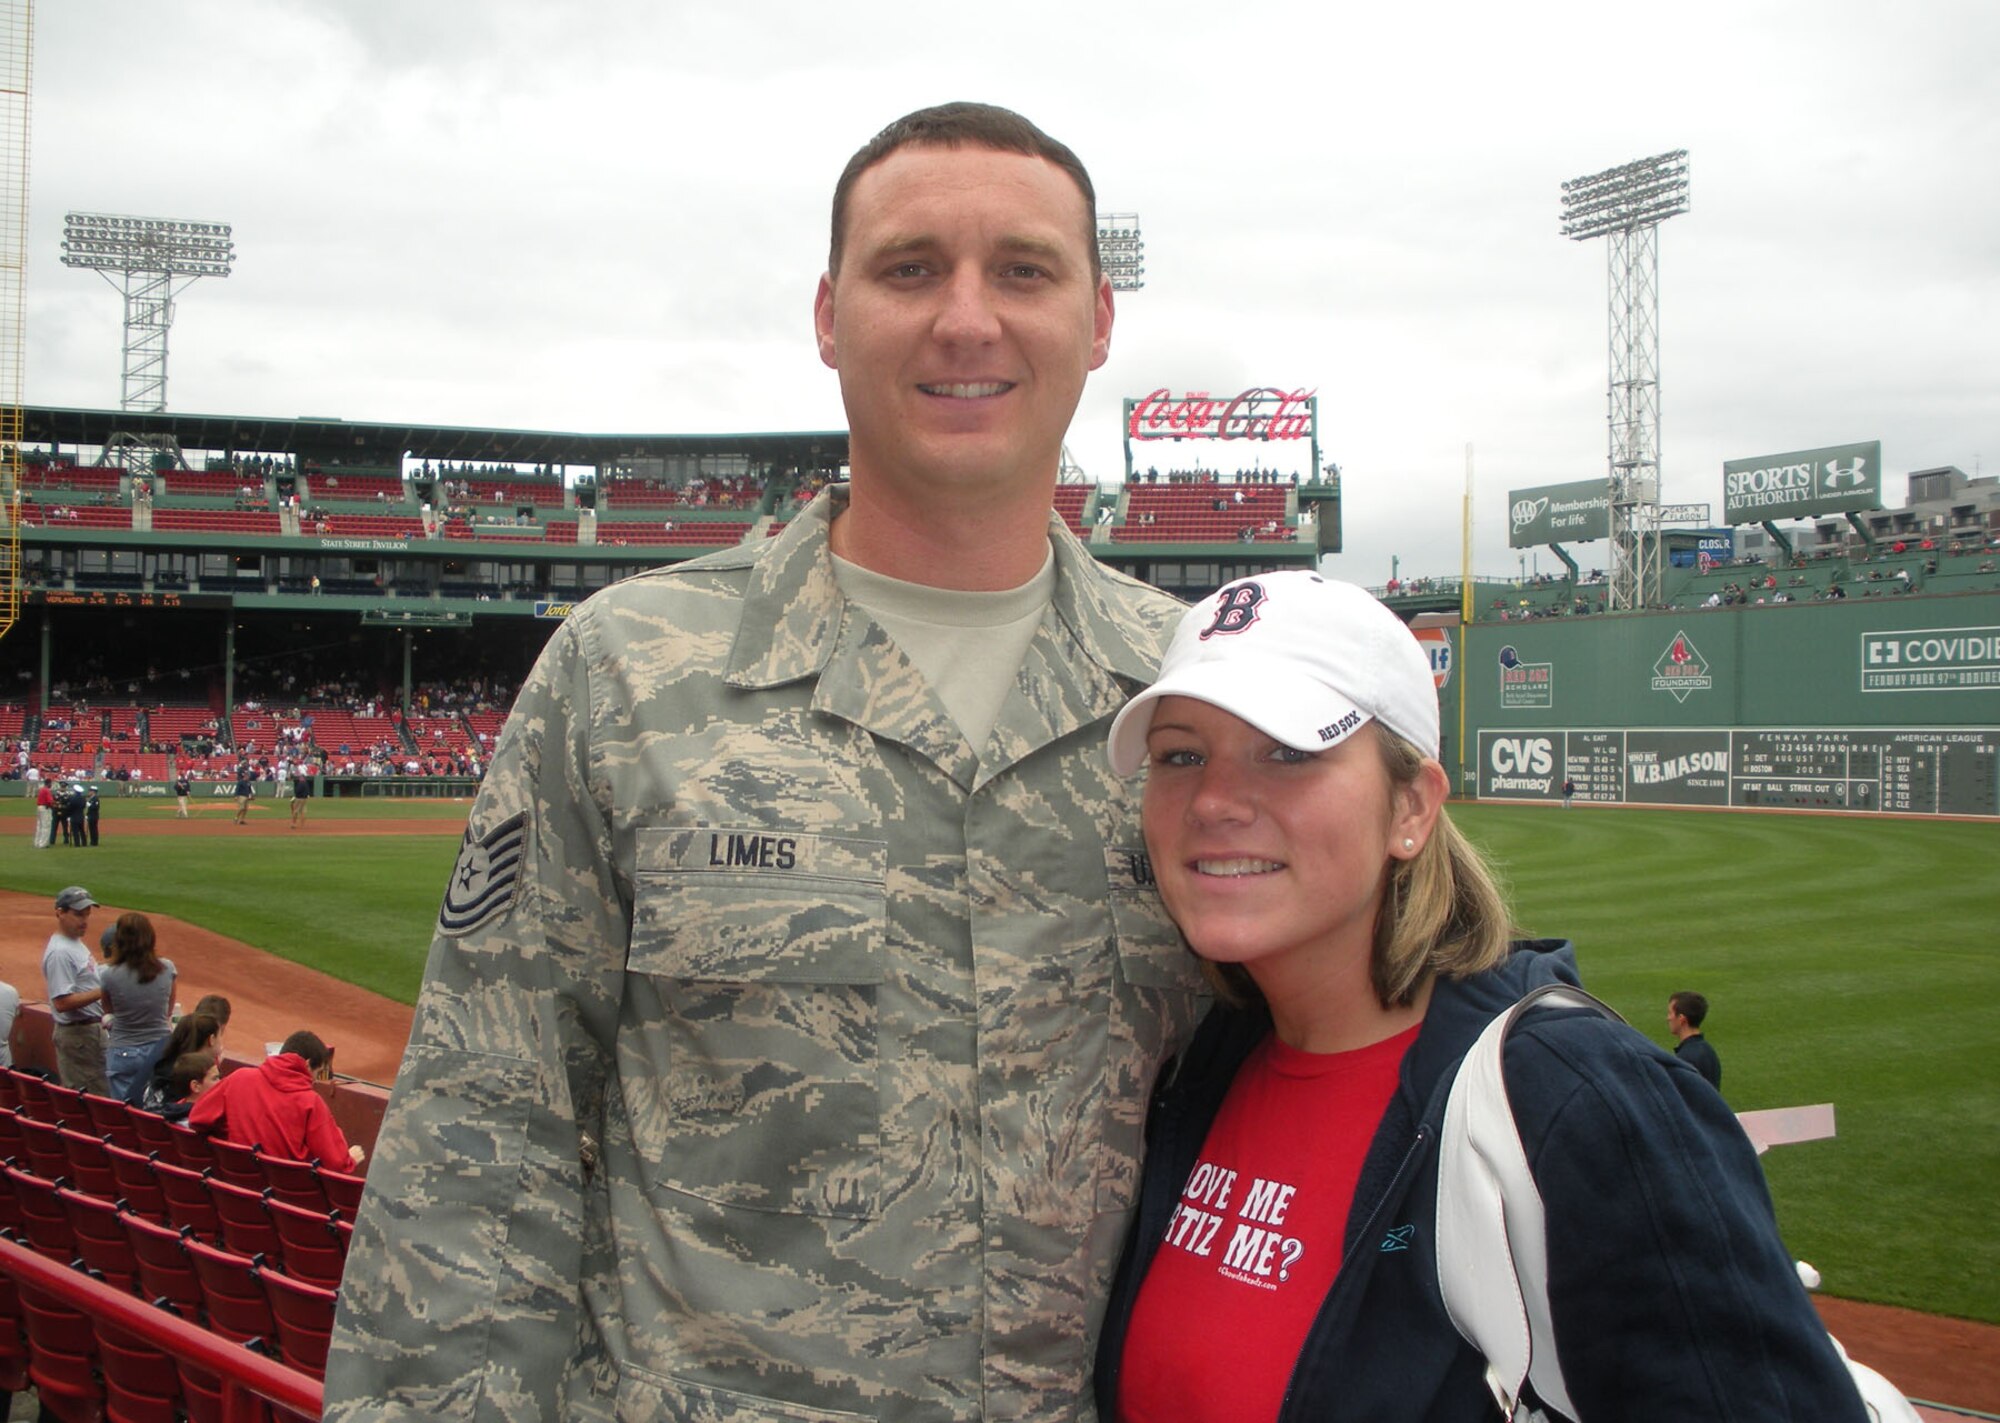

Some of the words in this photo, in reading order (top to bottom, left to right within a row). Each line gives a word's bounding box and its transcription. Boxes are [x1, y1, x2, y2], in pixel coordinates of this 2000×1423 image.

[1130, 387, 1318, 441] Coca-Cola
[1727, 463, 1810, 495] SPORTS
[1728, 487, 1811, 509] AUTHORITY
[1843, 488, 1874, 496] ARMOUR
[1551, 497, 1609, 513] Membership
[1551, 518, 1566, 528] For
[321, 539, 342, 548] STATE
[344, 540, 370, 548] STREET
[372, 540, 408, 550] PAVILION
[1199, 581, 1269, 641] B
[1506, 670, 1526, 683] RED
[1655, 679, 1708, 687] FOUNDATION
[1869, 675, 1906, 686] FENWAY
[1910, 673, 1935, 685] PARK
[1960, 672, 2000, 684] ANNIVE
[1318, 723, 1340, 742] RED
[1338, 710, 1361, 732] SOX
[1759, 734, 1808, 742] FENWAY
[1816, 734, 1848, 742] PARK
[1491, 738, 1552, 774] CVS
[1628, 753, 1643, 762] WHO
[1645, 752, 1658, 762] BUT
[1897, 756, 1910, 764] NYY
[1464, 772, 1476, 781] 310
[1687, 779, 1708, 787] SINCE
[214, 785, 255, 794] AVA
[1491, 775, 1552, 794] pharmacy
[710, 834, 796, 869] LIMES
[1182, 1159, 1238, 1210] OVE
[1238, 1178, 1297, 1225] ME
[1222, 1224, 1303, 1282] ME?
